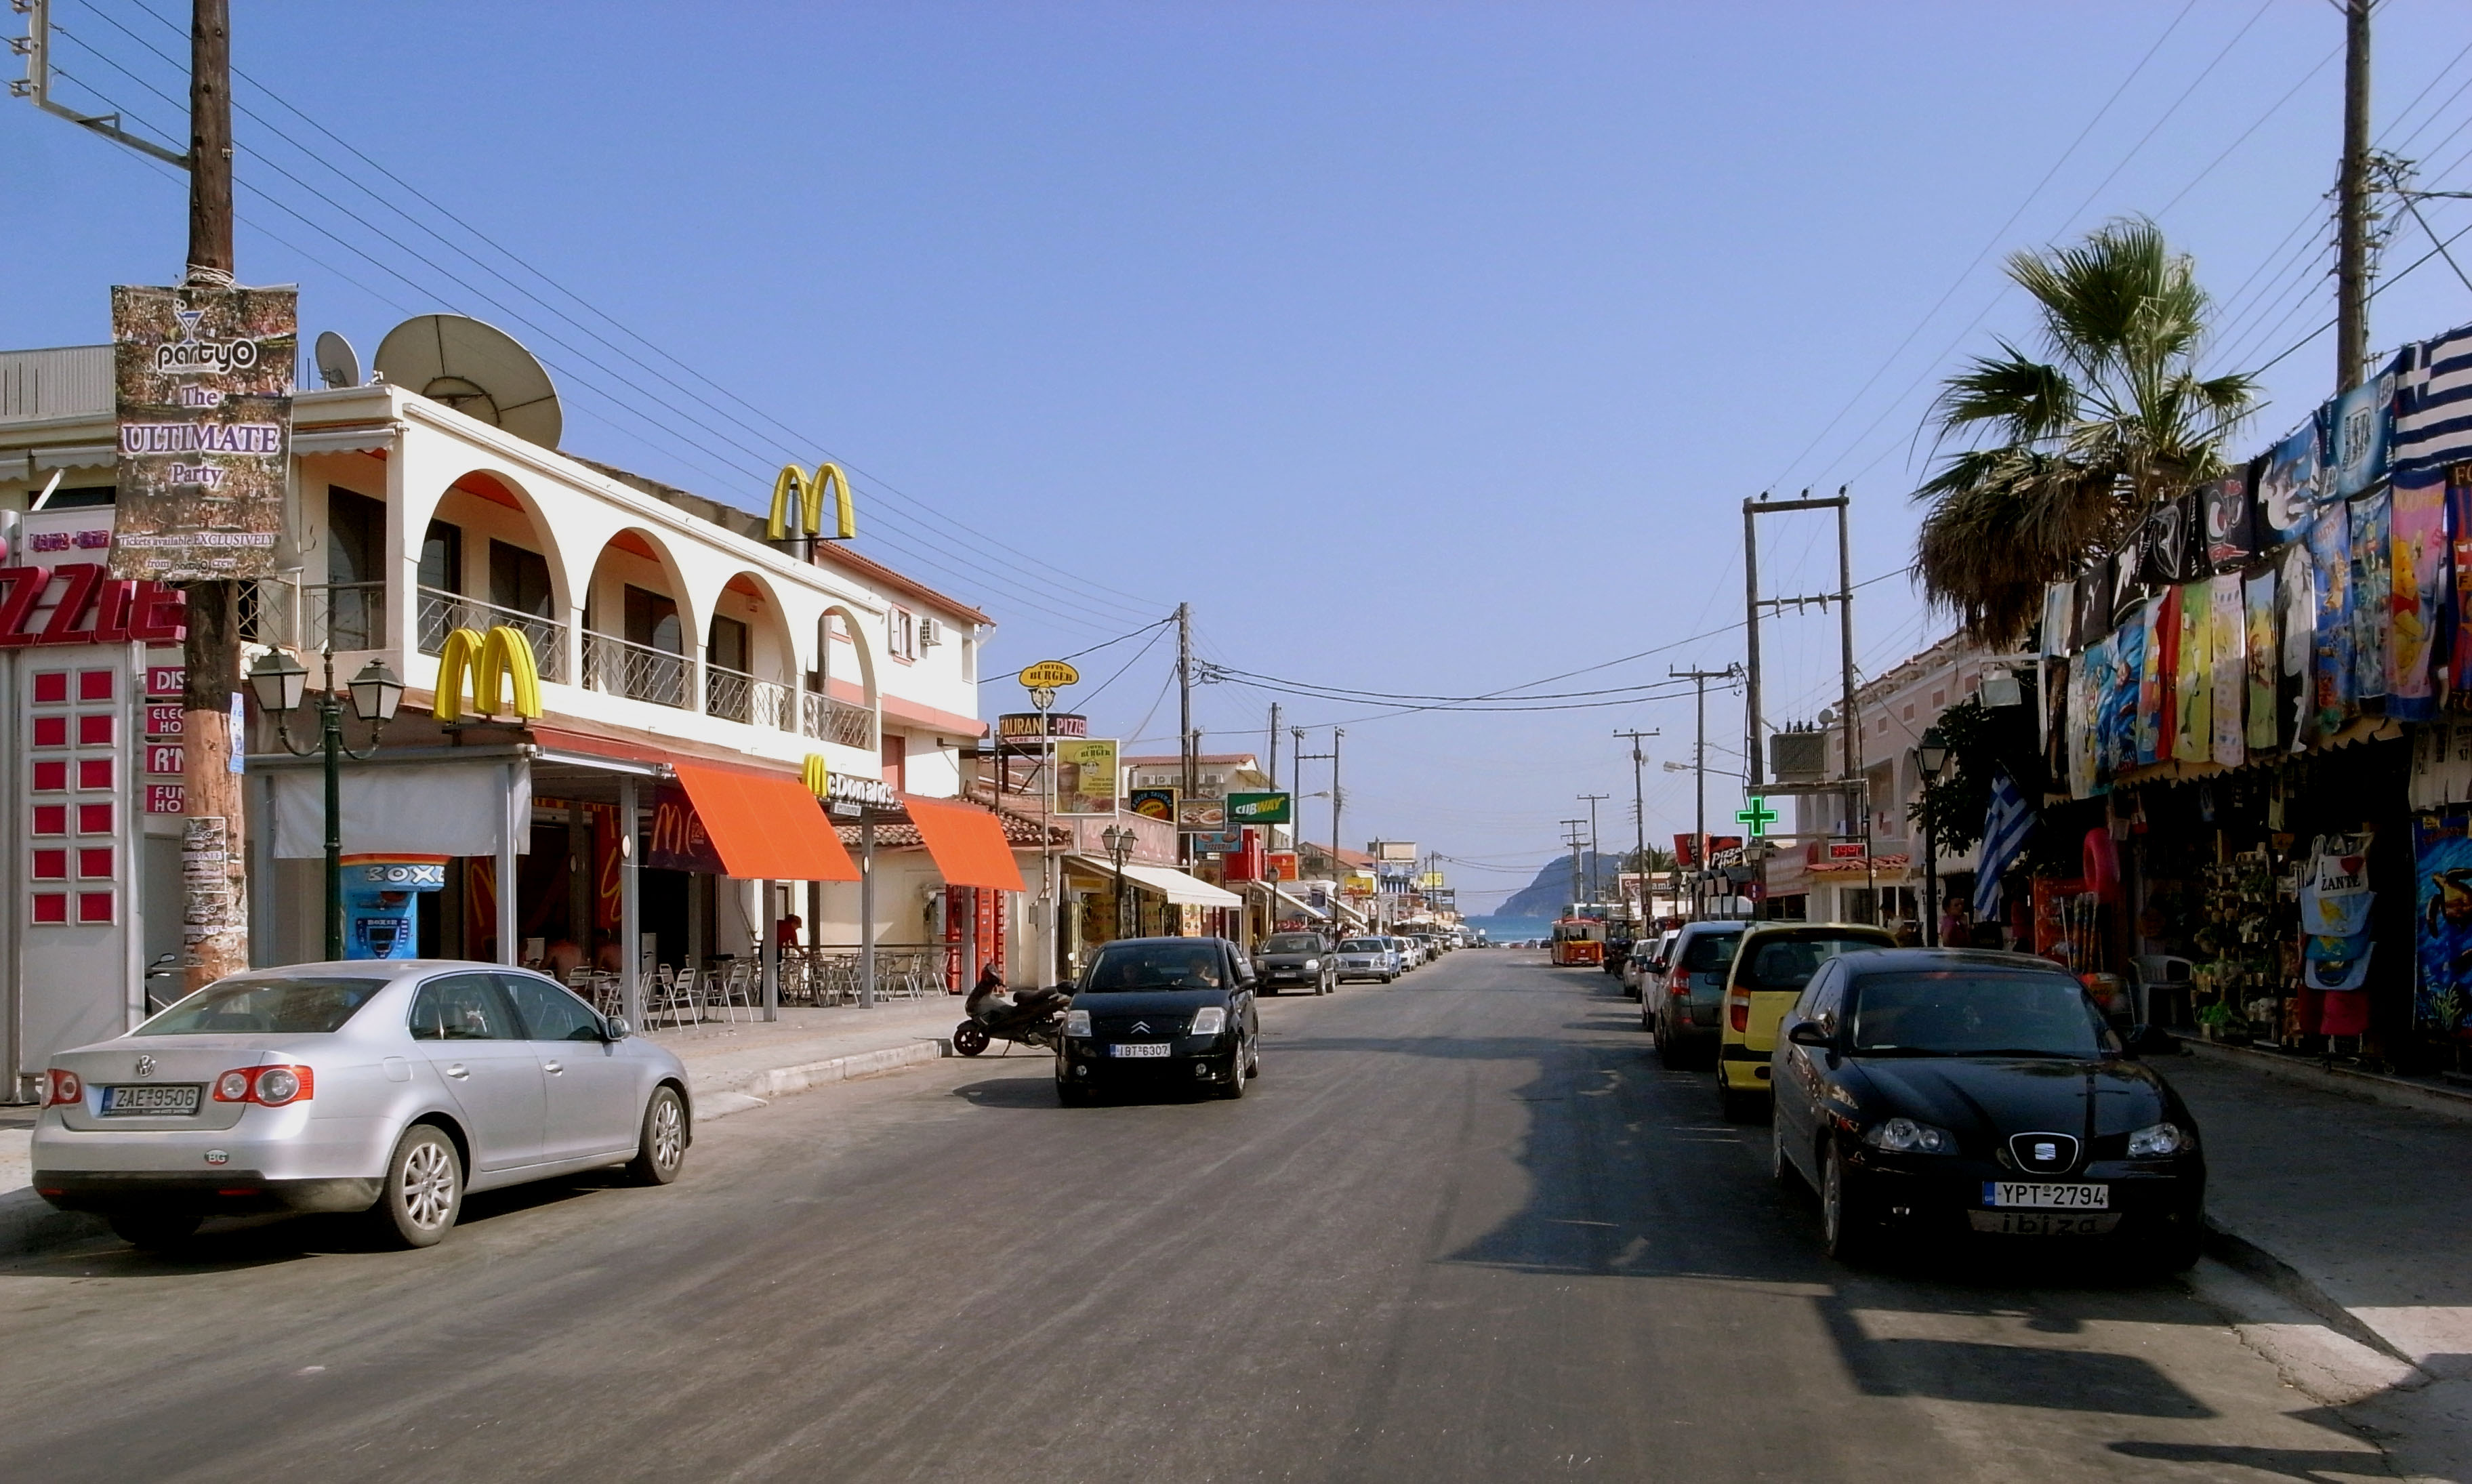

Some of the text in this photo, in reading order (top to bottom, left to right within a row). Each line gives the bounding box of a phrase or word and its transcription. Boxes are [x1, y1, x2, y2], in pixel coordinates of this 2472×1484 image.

[182, 387, 218, 405] The
[124, 425, 279, 453] ULTIMATE
[171, 464, 222, 484] Party
[120, 537, 151, 546] Tickets
[153, 536, 191, 545] available
[193, 534, 274, 545] EXCLUSIVELY
[146, 560, 169, 568] from
[212, 559, 233, 567] crew
[1030, 671, 1073, 682] BURGER
[1081, 749, 1111, 758] BURGER
[1711, 846, 1742, 867] Pizza
[2322, 875, 2360, 891] ZANTE
[209, 1154, 226, 1162] BG
